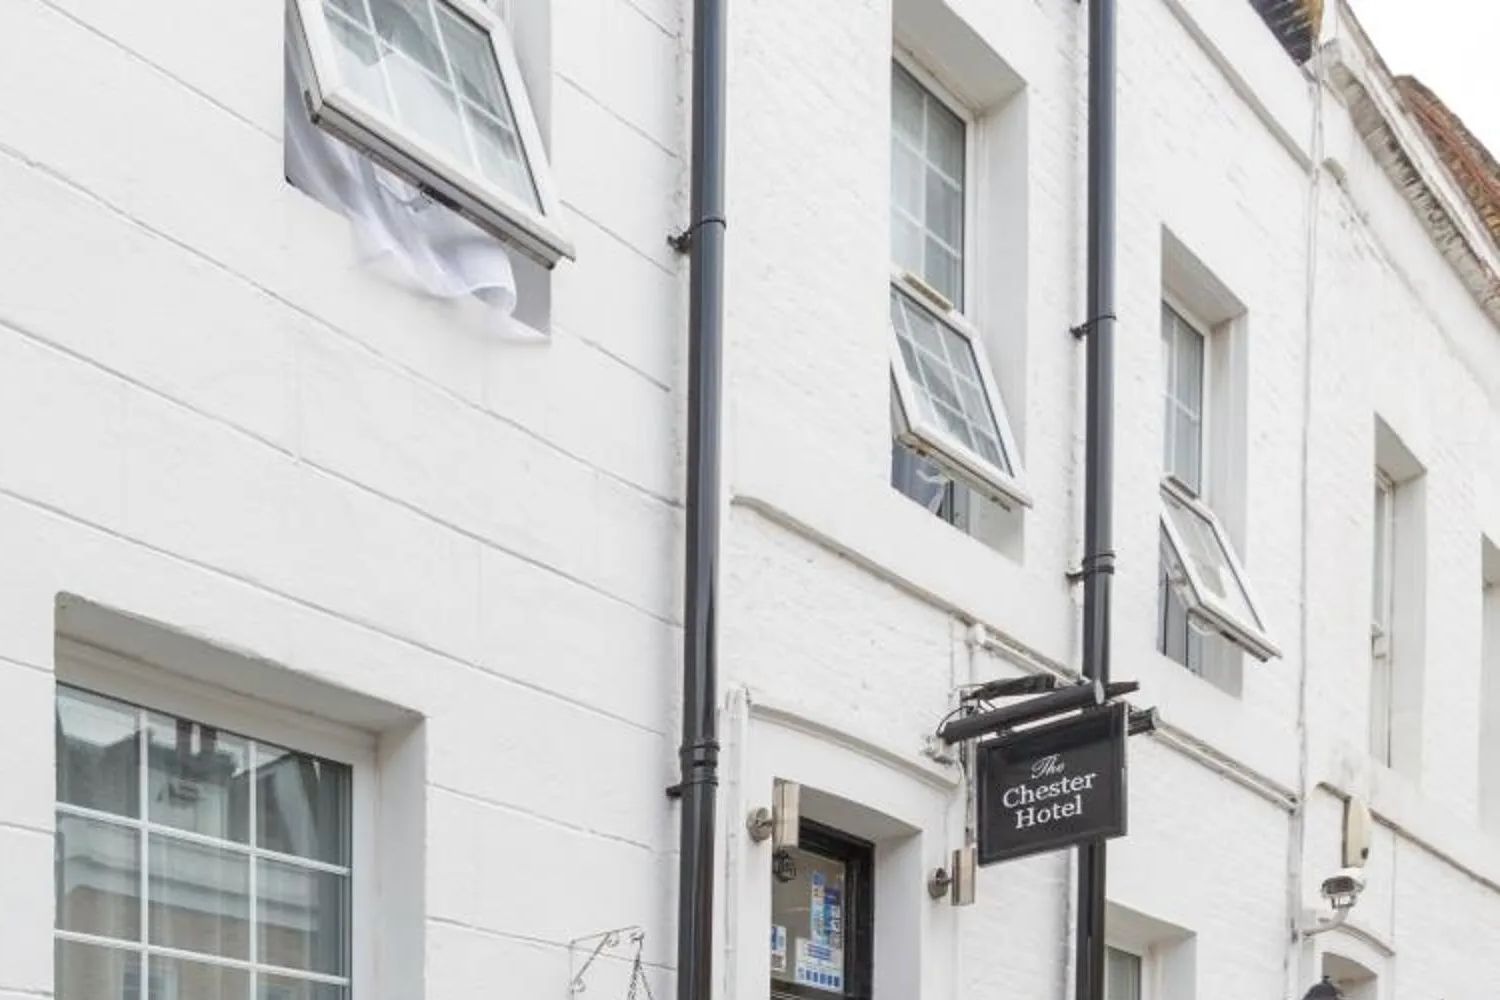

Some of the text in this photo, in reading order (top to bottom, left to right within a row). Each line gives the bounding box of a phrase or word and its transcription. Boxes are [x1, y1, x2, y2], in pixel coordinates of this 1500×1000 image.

[1031, 753, 1065, 780] The
[1002, 772, 1097, 809] Chester
[1015, 794, 1083, 829] Hotel
